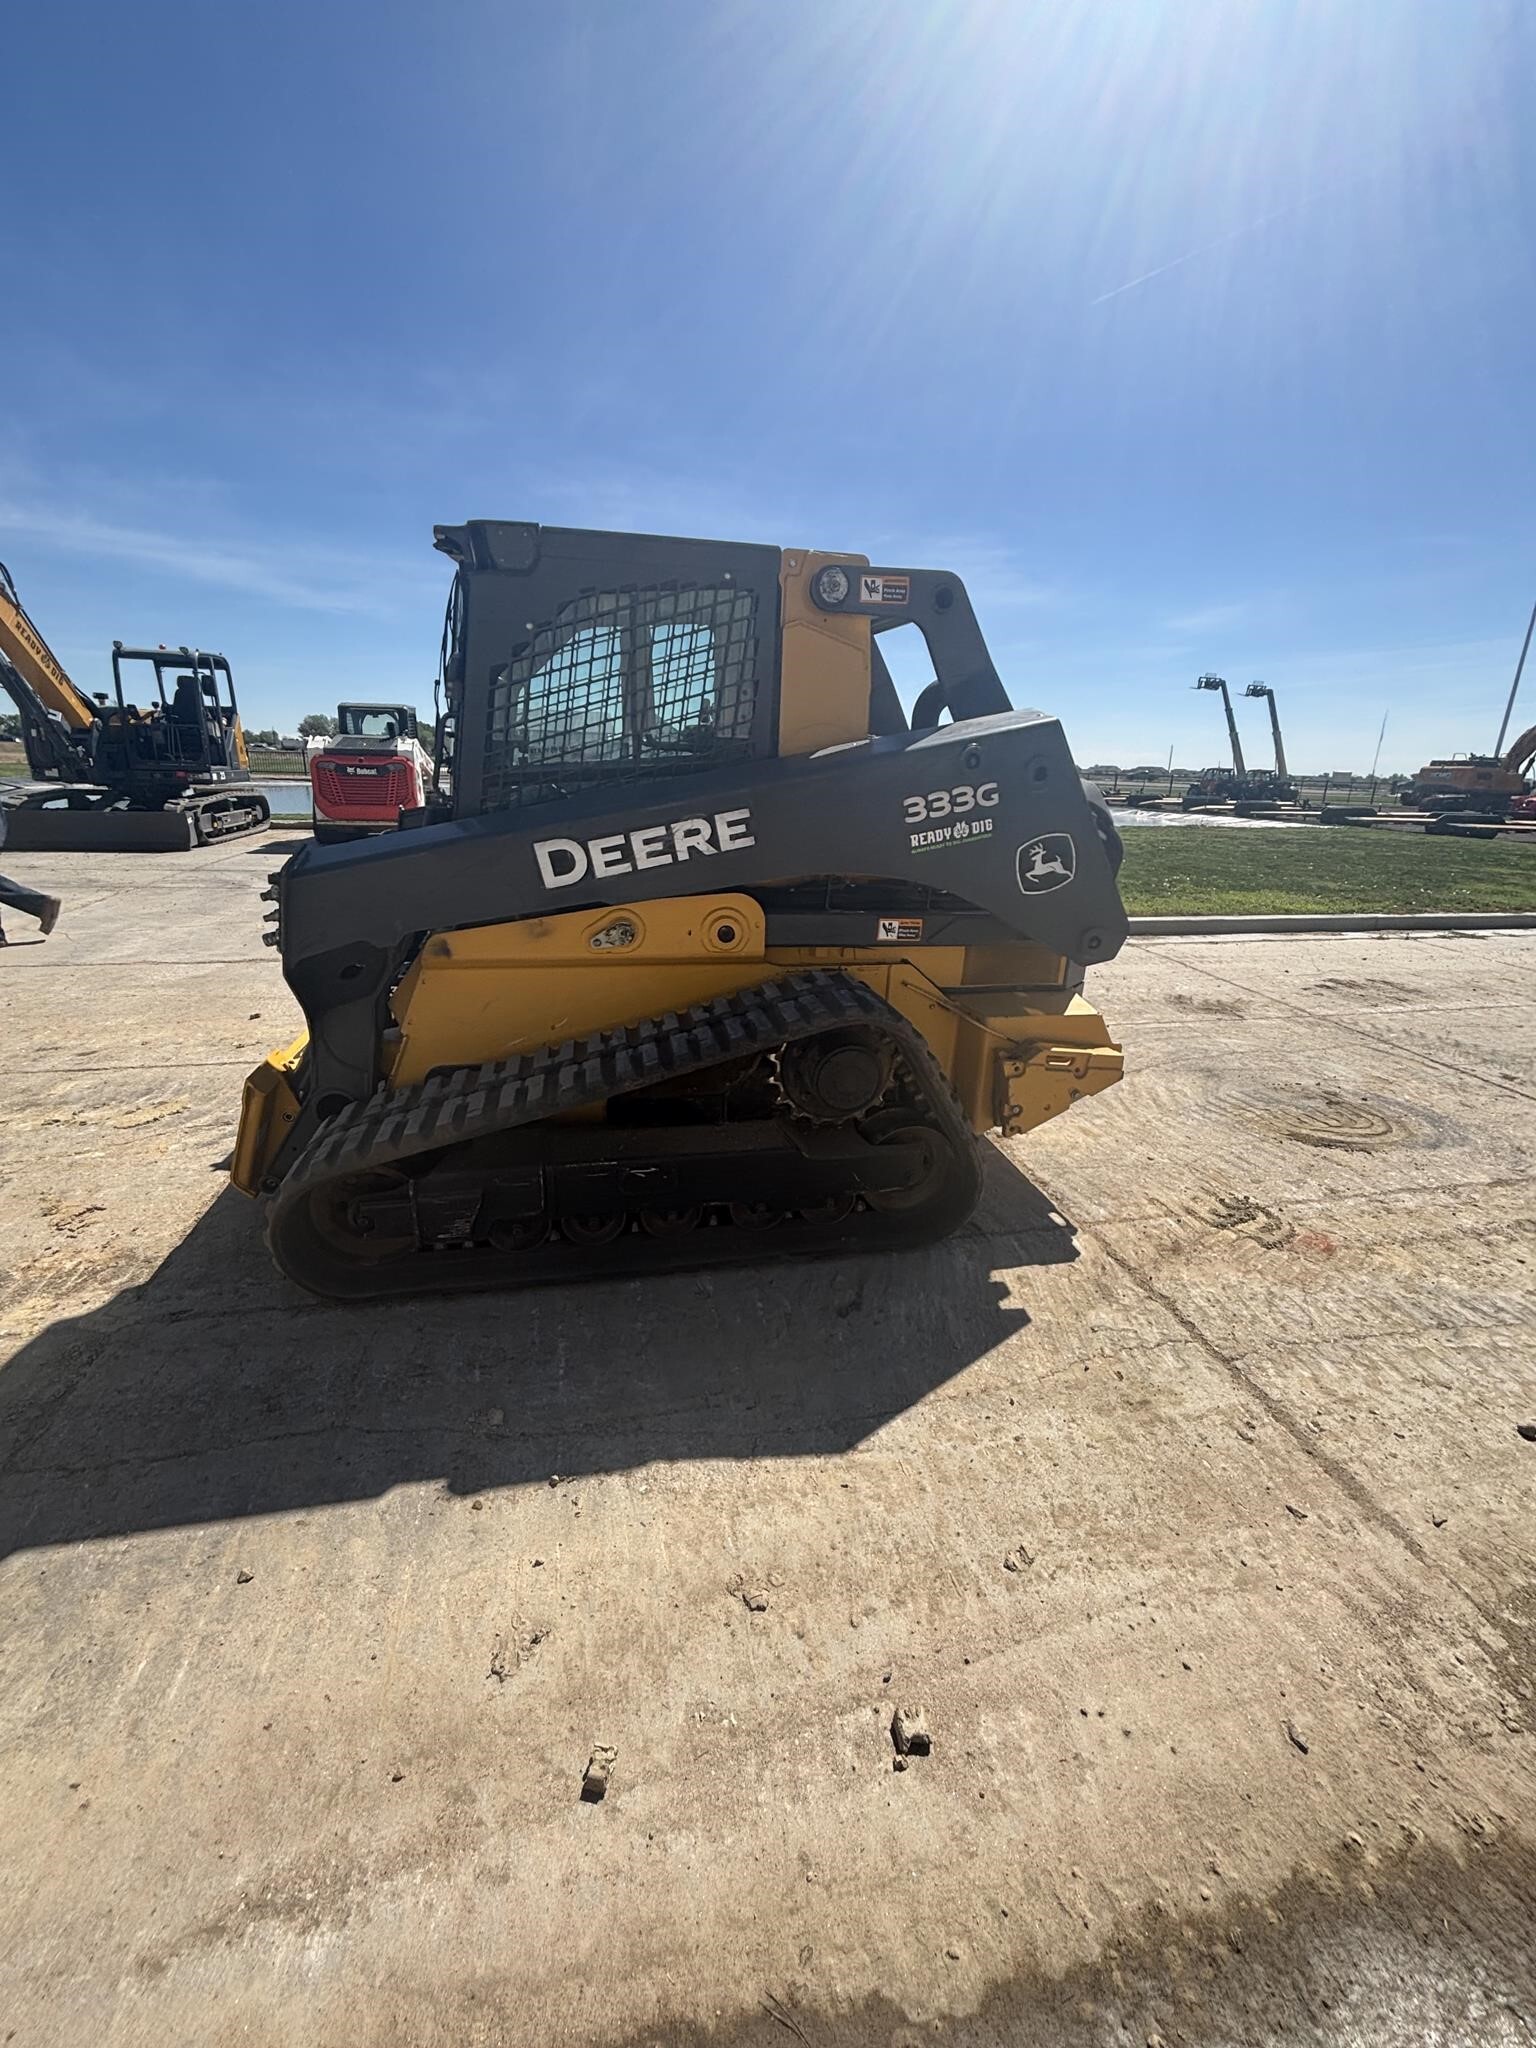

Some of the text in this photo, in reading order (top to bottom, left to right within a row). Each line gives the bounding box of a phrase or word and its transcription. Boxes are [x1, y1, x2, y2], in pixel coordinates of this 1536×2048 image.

[15, 620, 42, 655] READY
[903, 782, 999, 823] 333G
[533, 808, 756, 889] DEERE
[910, 827, 952, 847] READY
[971, 818, 993, 834] DIG
